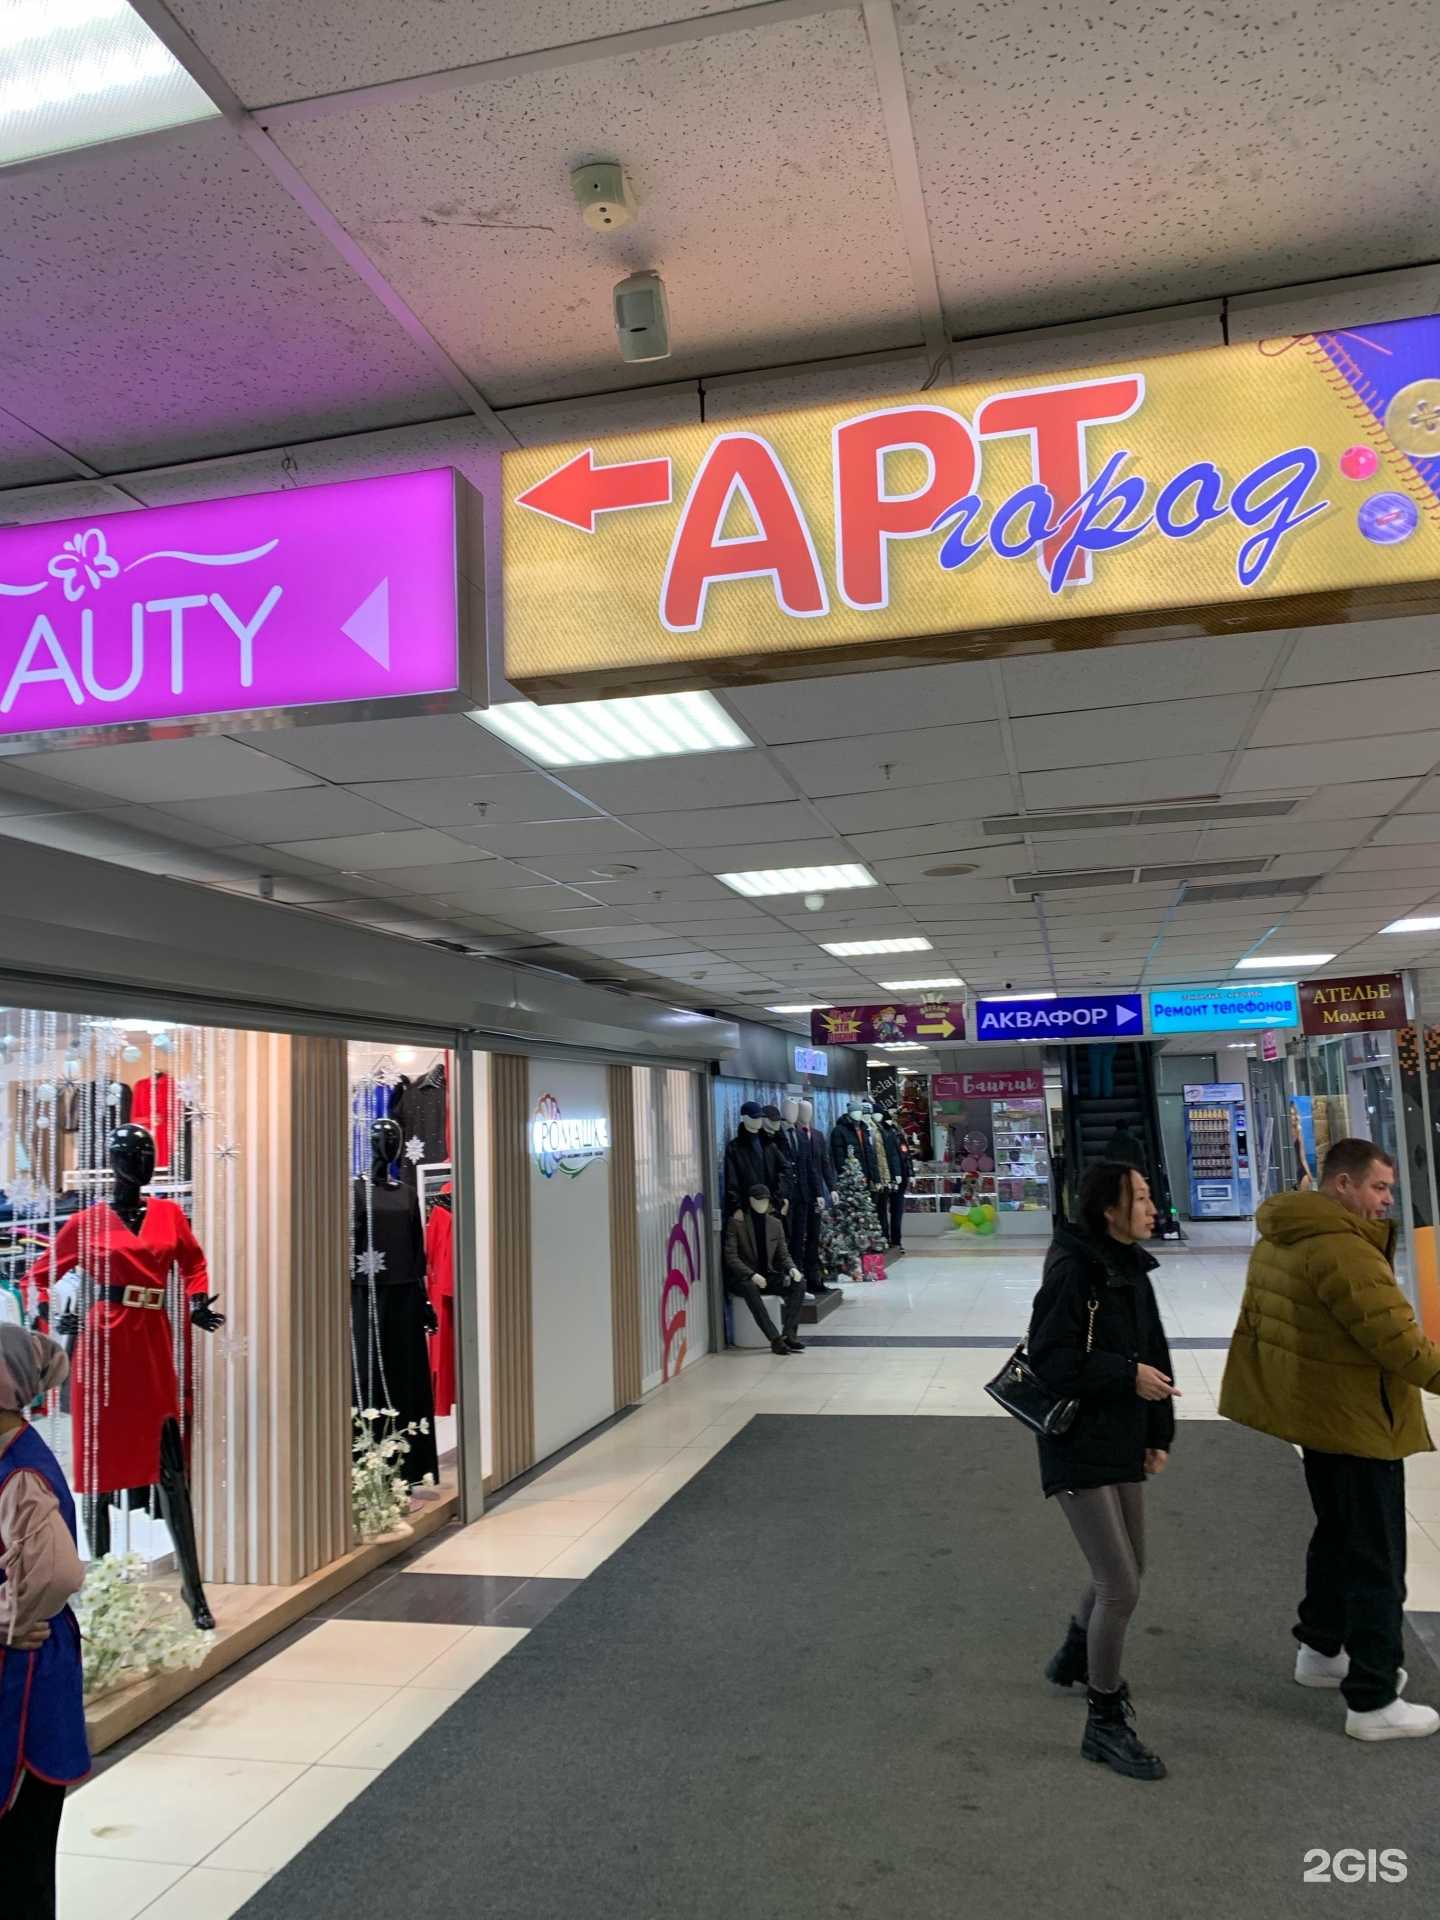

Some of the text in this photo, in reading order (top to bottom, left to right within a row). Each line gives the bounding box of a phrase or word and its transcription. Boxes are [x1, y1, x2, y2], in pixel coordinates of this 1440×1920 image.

[658, 373, 1146, 632] АРТ
[929, 446, 1329, 596] город
[0, 585, 283, 713] AUTY
[981, 1008, 1108, 1029] АКВАФОР
[1154, 1000, 1292, 1017] Ремонт телефонов
[1312, 983, 1392, 1004] АТЕЛЬЕ
